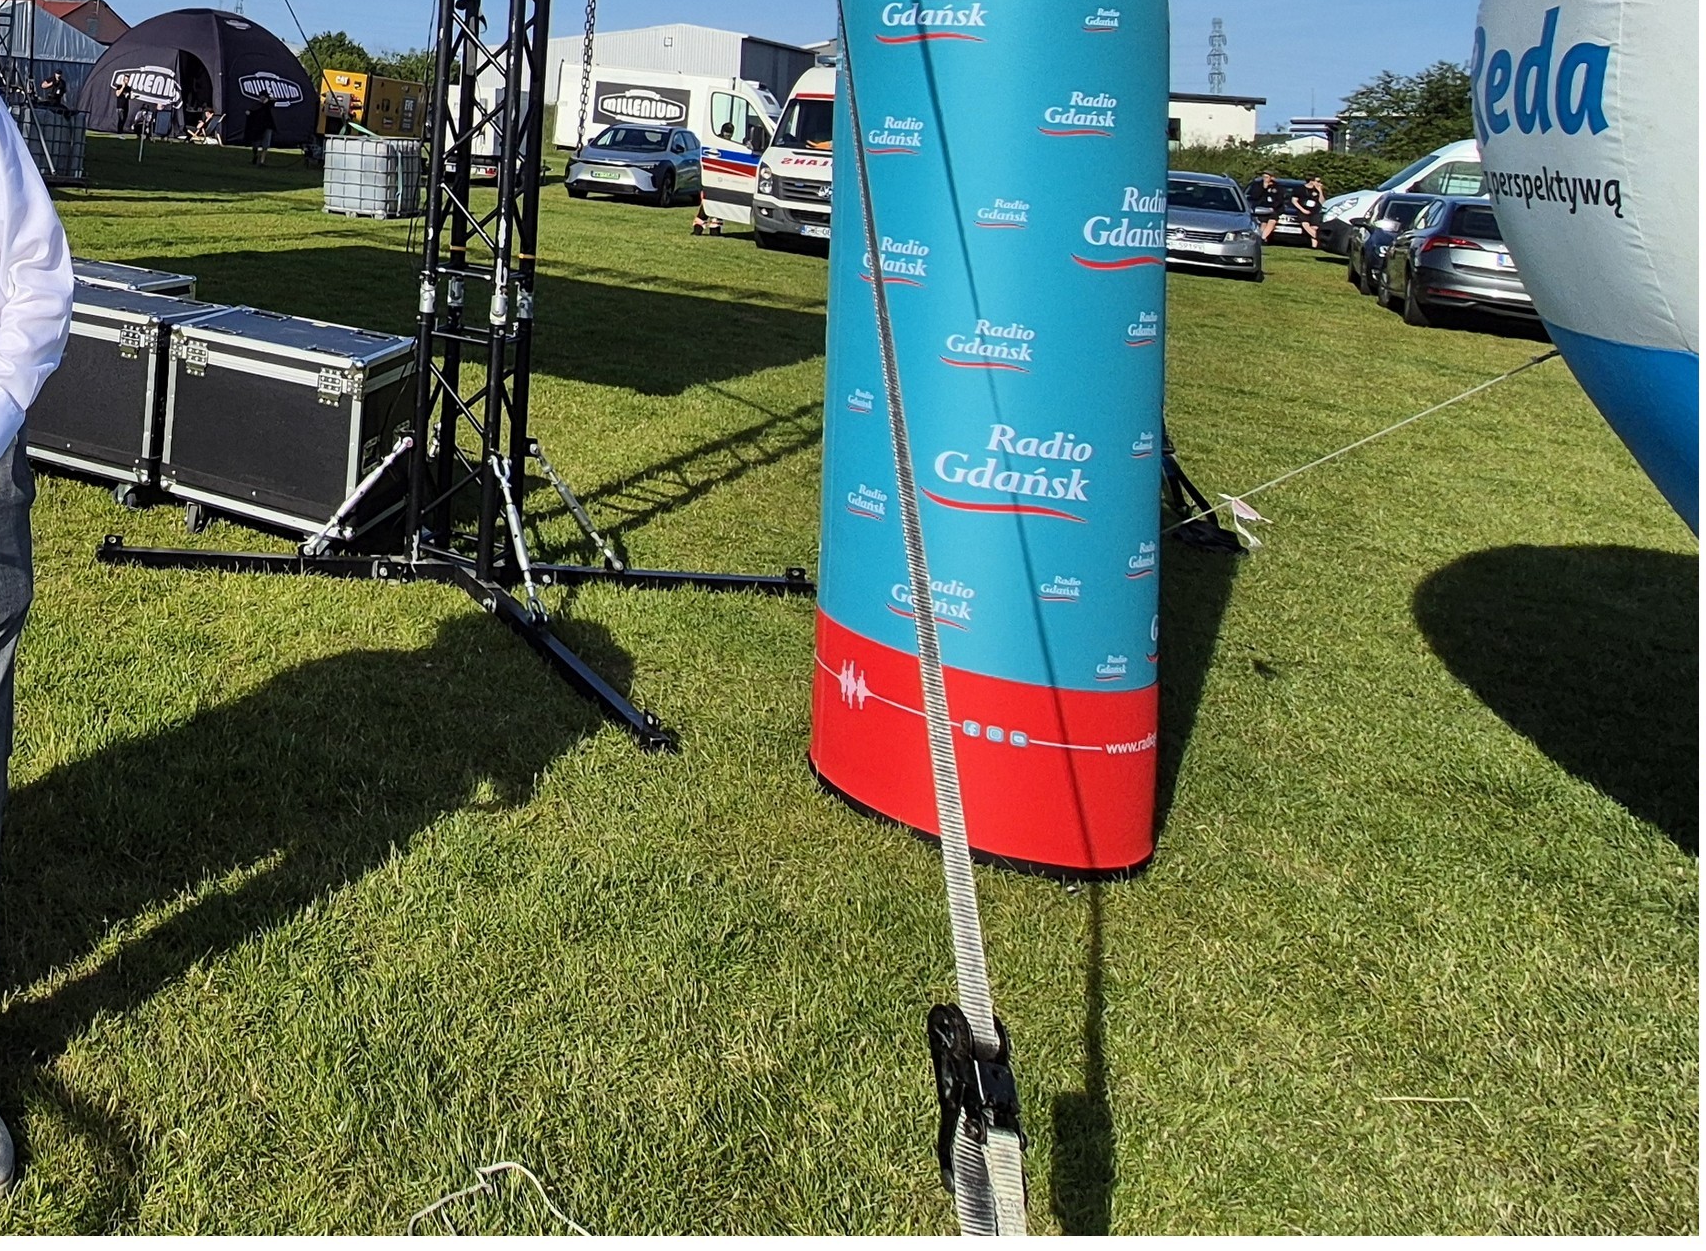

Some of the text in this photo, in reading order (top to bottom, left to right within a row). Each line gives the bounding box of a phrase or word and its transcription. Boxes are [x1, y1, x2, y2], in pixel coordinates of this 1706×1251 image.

[882, 2, 988, 26] Gdańsk
[1097, 8, 1120, 17] Radio
[1085, 16, 1119, 27] Gdańsk
[1070, 91, 1117, 108] Radio
[603, 98, 681, 118] MILLENIUM
[884, 116, 924, 130] Radio
[1044, 107, 1115, 127] Gdańsk
[868, 130, 922, 147] Gdańsk
[1490, 166, 1623, 219] perspektywą
[994, 198, 1030, 211] Radio
[977, 208, 1029, 223] Gdańsk
[881, 236, 929, 257] Radio
[1139, 311, 1158, 322] Radio
[975, 318, 1035, 341] Radio
[1127, 324, 1157, 337] Gdańsk
[946, 334, 1033, 362] Gdańsk
[847, 394, 873, 410] Gdańsk
[855, 388, 874, 400] Radio
[986, 424, 1092, 462] Radio
[934, 450, 1091, 502] Gdańsk
[858, 484, 888, 501] Radio
[847, 492, 885, 515] Gdańsk
[1054, 575, 1081, 587] Radio
[1040, 583, 1080, 597] Gdańsk
[1107, 655, 1128, 665] Radio
[1096, 663, 1127, 675] Gdańsk
